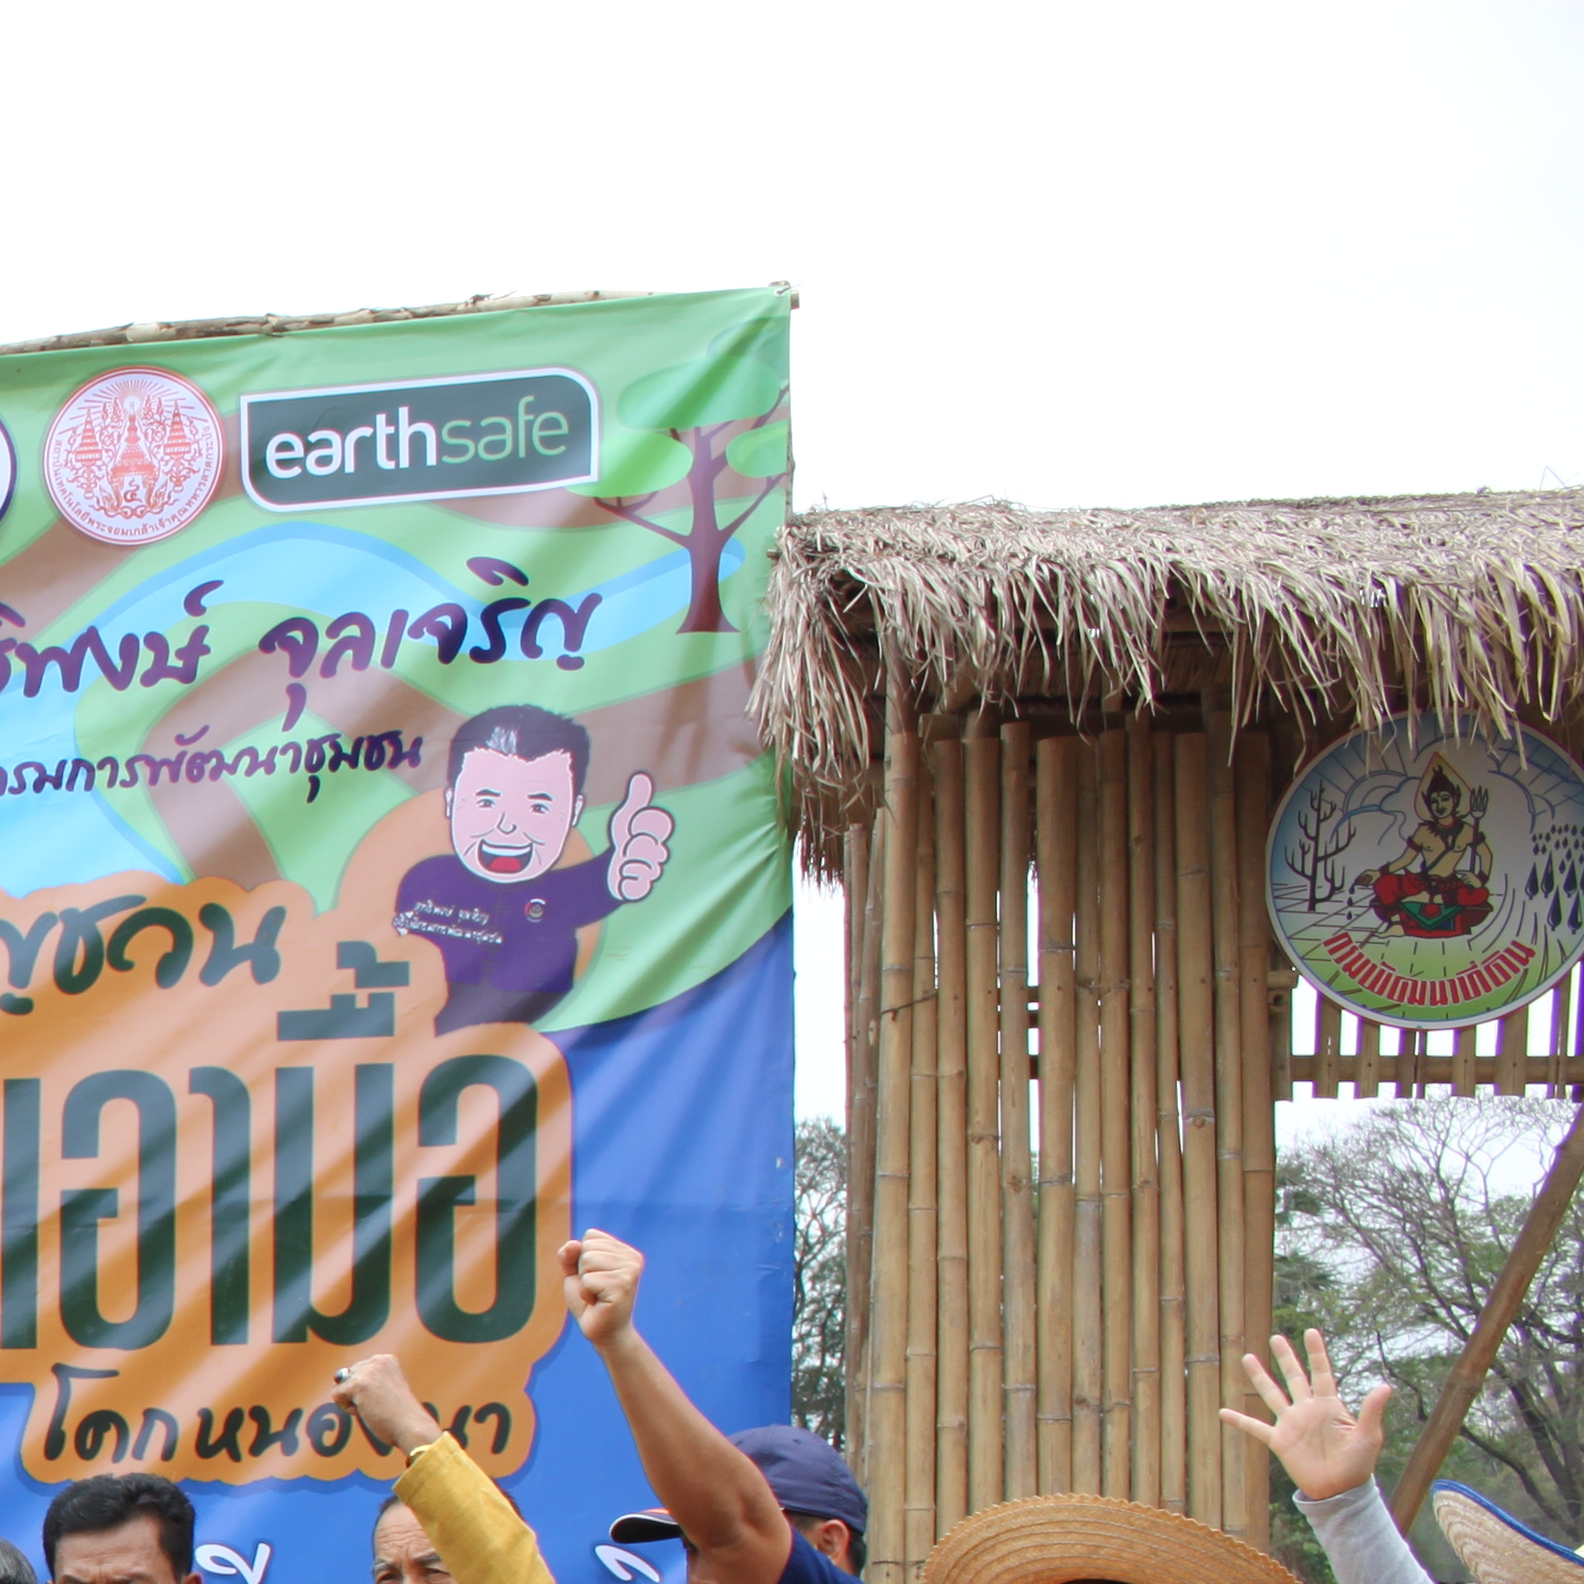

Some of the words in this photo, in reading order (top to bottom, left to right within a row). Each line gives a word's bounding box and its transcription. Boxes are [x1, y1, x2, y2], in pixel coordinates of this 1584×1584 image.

[264, 394, 570, 479] earthsafe
[257, 556, 603, 731] จุลเจริญ
[0, 940, 540, 1351] เอามื้อ
